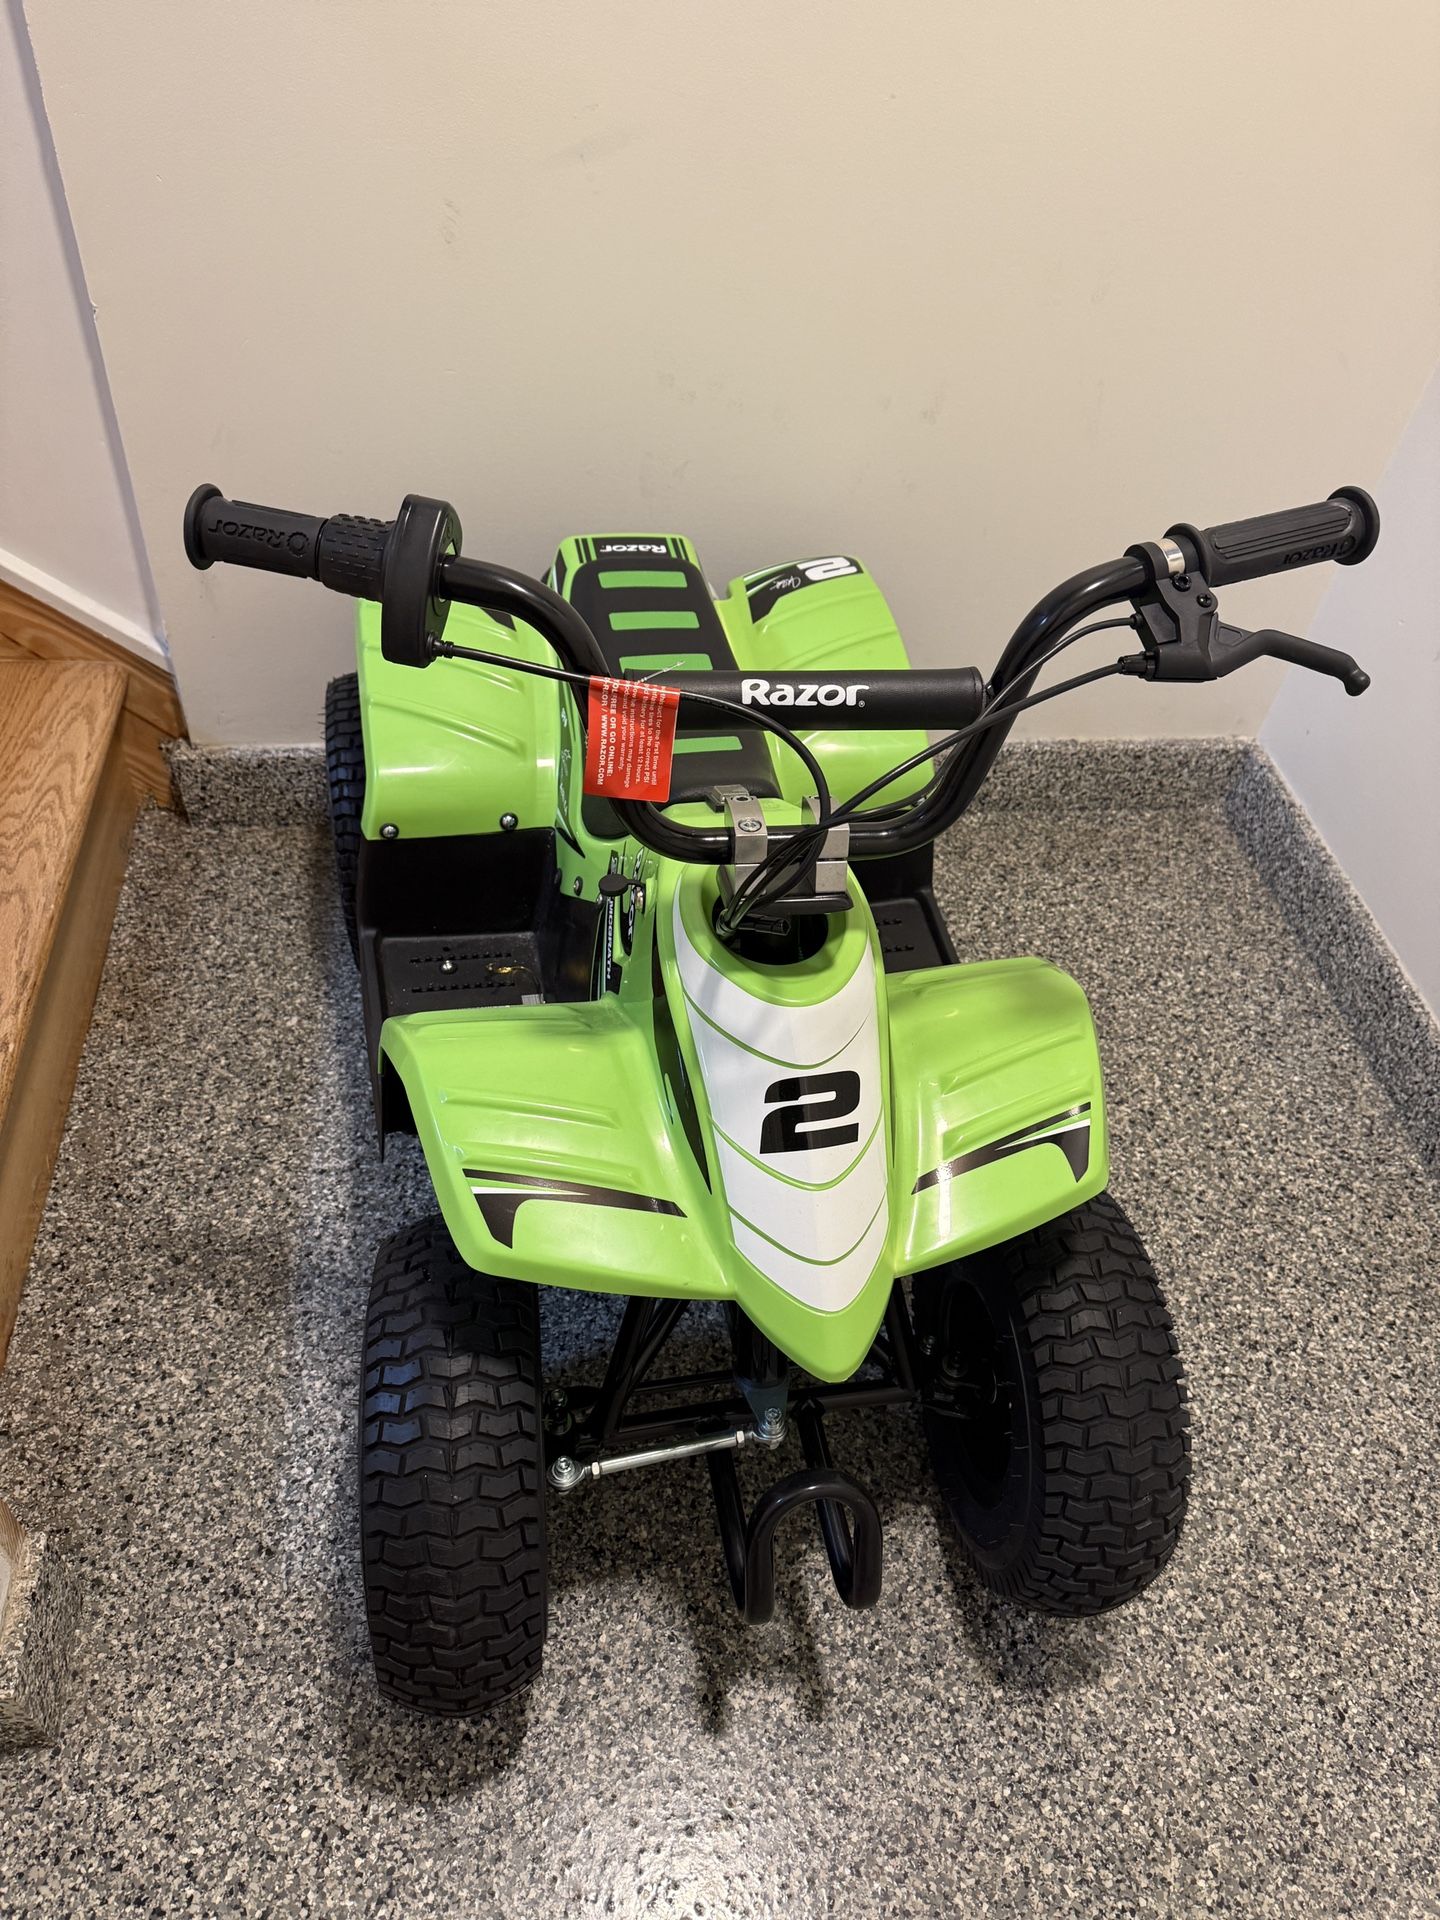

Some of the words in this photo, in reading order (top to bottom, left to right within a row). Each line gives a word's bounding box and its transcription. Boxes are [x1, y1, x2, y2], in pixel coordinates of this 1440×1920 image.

[208, 519, 285, 549] Razor
[600, 544, 667, 554] Razor
[1282, 542, 1338, 565] Razor
[796, 556, 858, 582] 2
[741, 678, 870, 708] Razor
[610, 717, 617, 729] OR
[628, 708, 636, 748] instructions
[647, 727, 653, 735] to
[597, 714, 608, 785] WWW.RAZOR.COM
[609, 731, 616, 744] GO
[607, 745, 615, 777] ONLINE:
[624, 763, 632, 788] damage
[759, 1070, 861, 1154] 2
